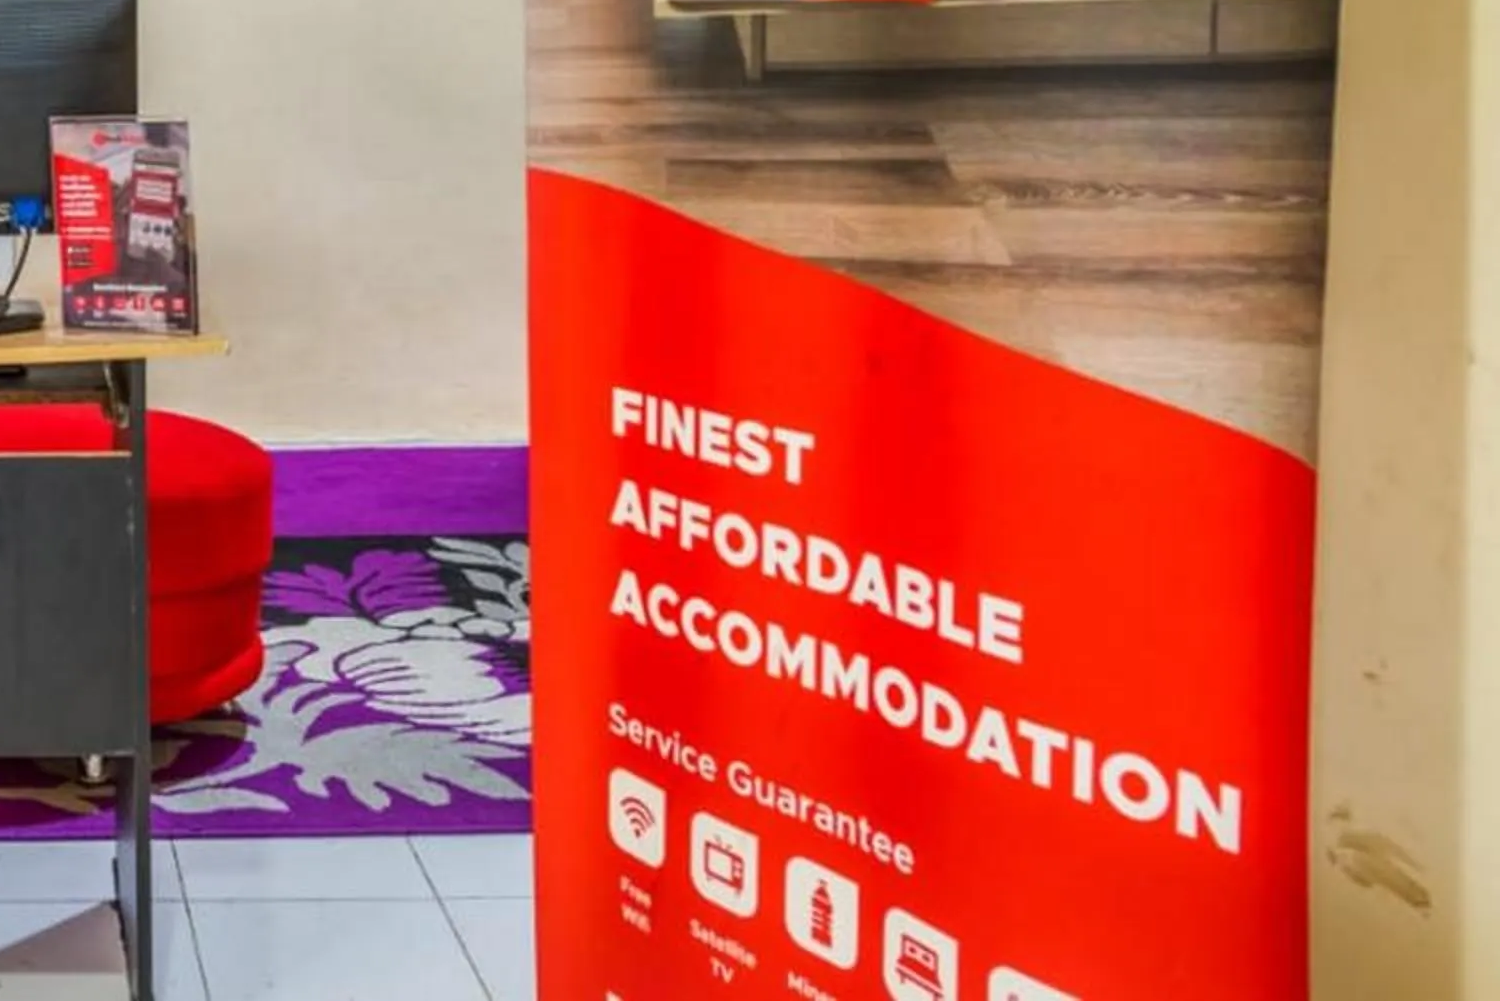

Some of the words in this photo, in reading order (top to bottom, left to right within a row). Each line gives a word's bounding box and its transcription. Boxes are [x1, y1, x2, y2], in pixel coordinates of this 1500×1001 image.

[611, 386, 814, 485] FINEST
[610, 479, 1023, 663] AFFORDABLE
[608, 704, 717, 782] Service
[727, 761, 915, 875] Guarantee
[610, 570, 1242, 855] ACCOMMODATION
[710, 956, 734, 984] TV
